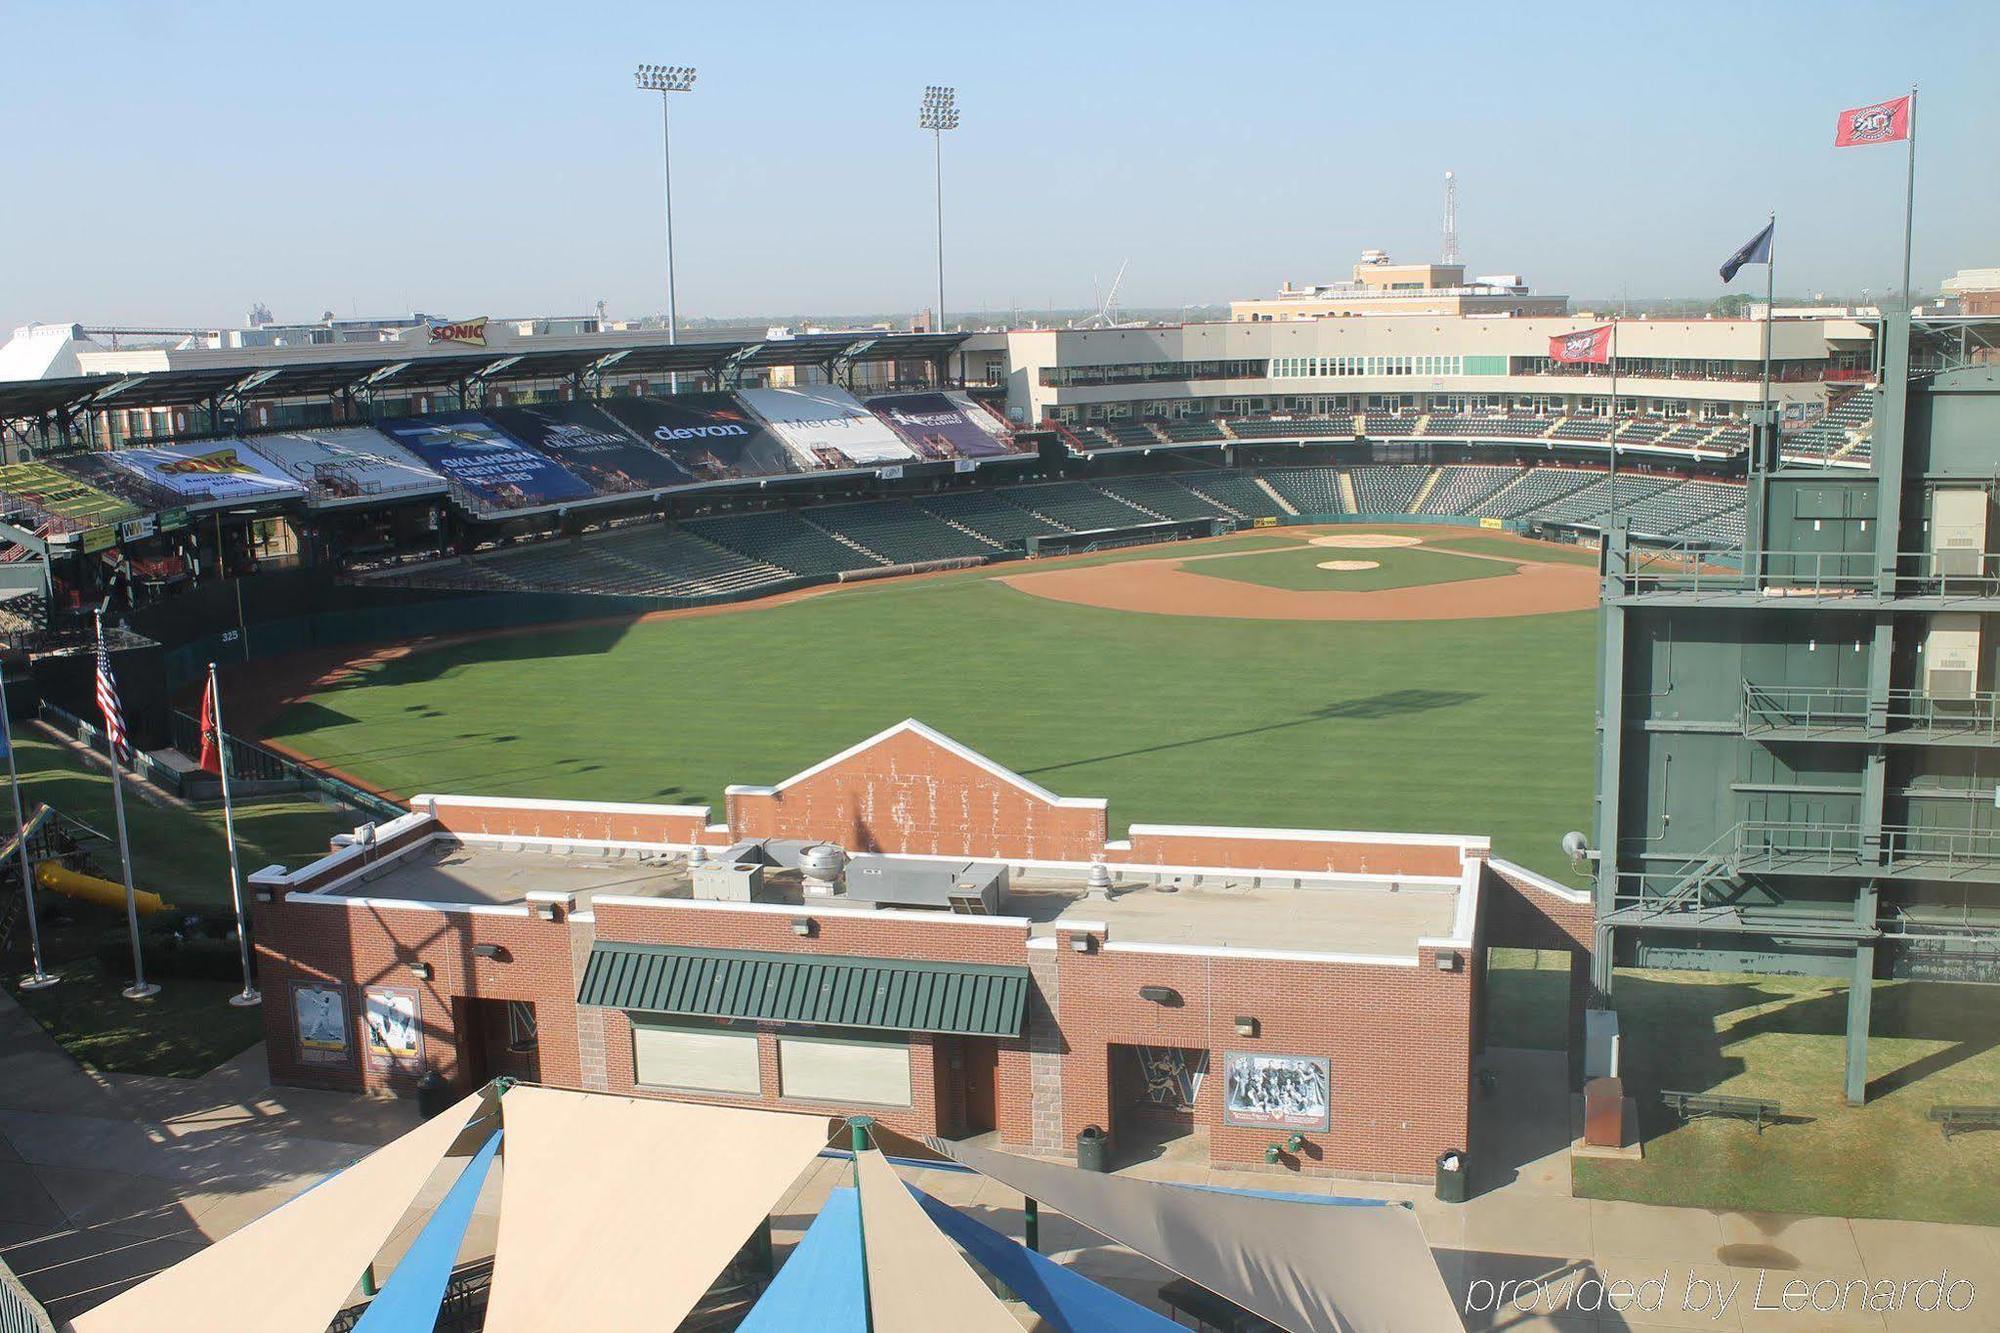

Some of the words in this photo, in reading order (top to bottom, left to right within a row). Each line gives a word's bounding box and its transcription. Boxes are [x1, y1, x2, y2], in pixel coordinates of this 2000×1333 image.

[432, 325, 483, 340] SONIC
[784, 417, 848, 430] Mercy
[654, 424, 748, 441] devon
[441, 452, 539, 467] OKLAHOMA
[455, 464, 503, 476] CHEVY
[504, 461, 545, 472] TEAM
[222, 630, 239, 642] 325
